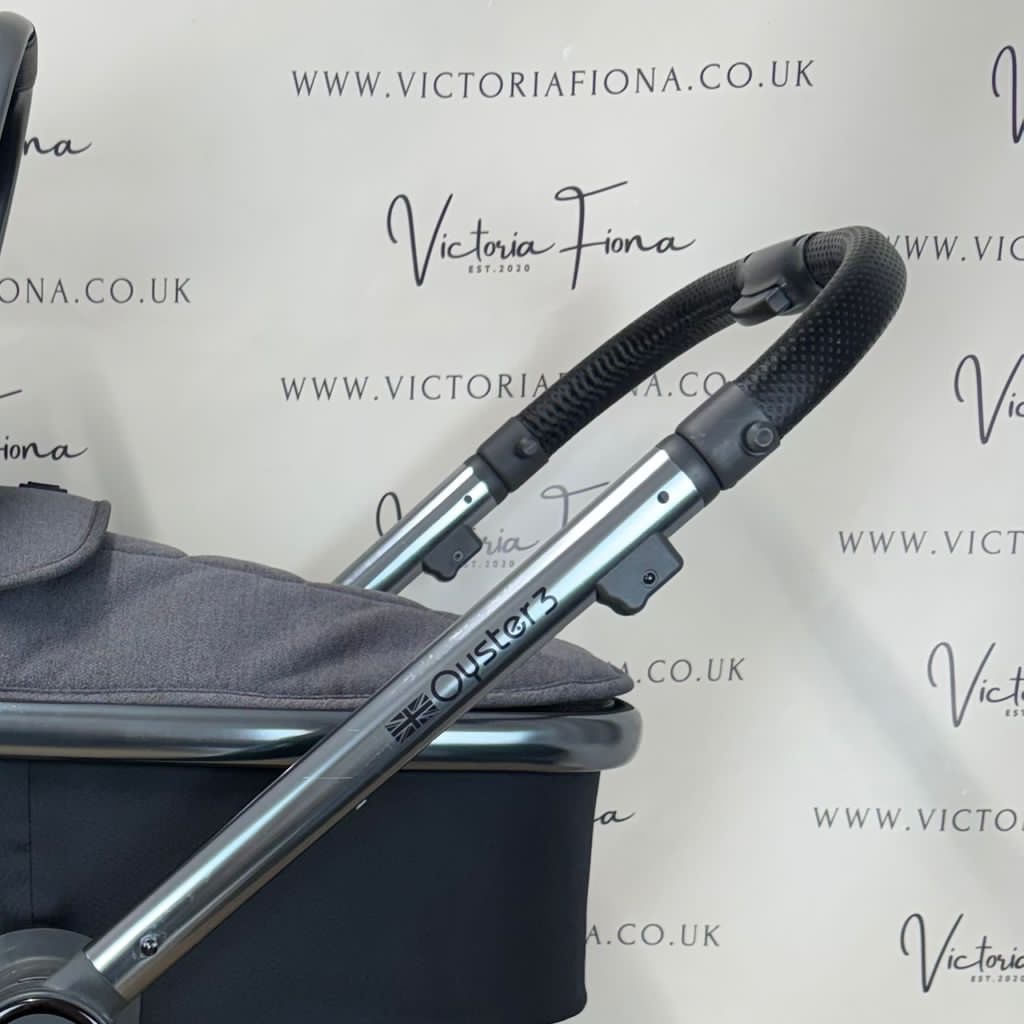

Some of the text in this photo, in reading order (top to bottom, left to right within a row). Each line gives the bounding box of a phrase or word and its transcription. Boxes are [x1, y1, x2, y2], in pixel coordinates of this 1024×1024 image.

[292, 60, 814, 98] WWW.VICTORIAFIONA.CO.UK
[387, 181, 696, 290] Victoria Fiona
[889, 235, 1024, 262] WW.VIC
[468, 264, 530, 273] EST.2020
[814, 807, 1024, 832] WWW.VICTO
